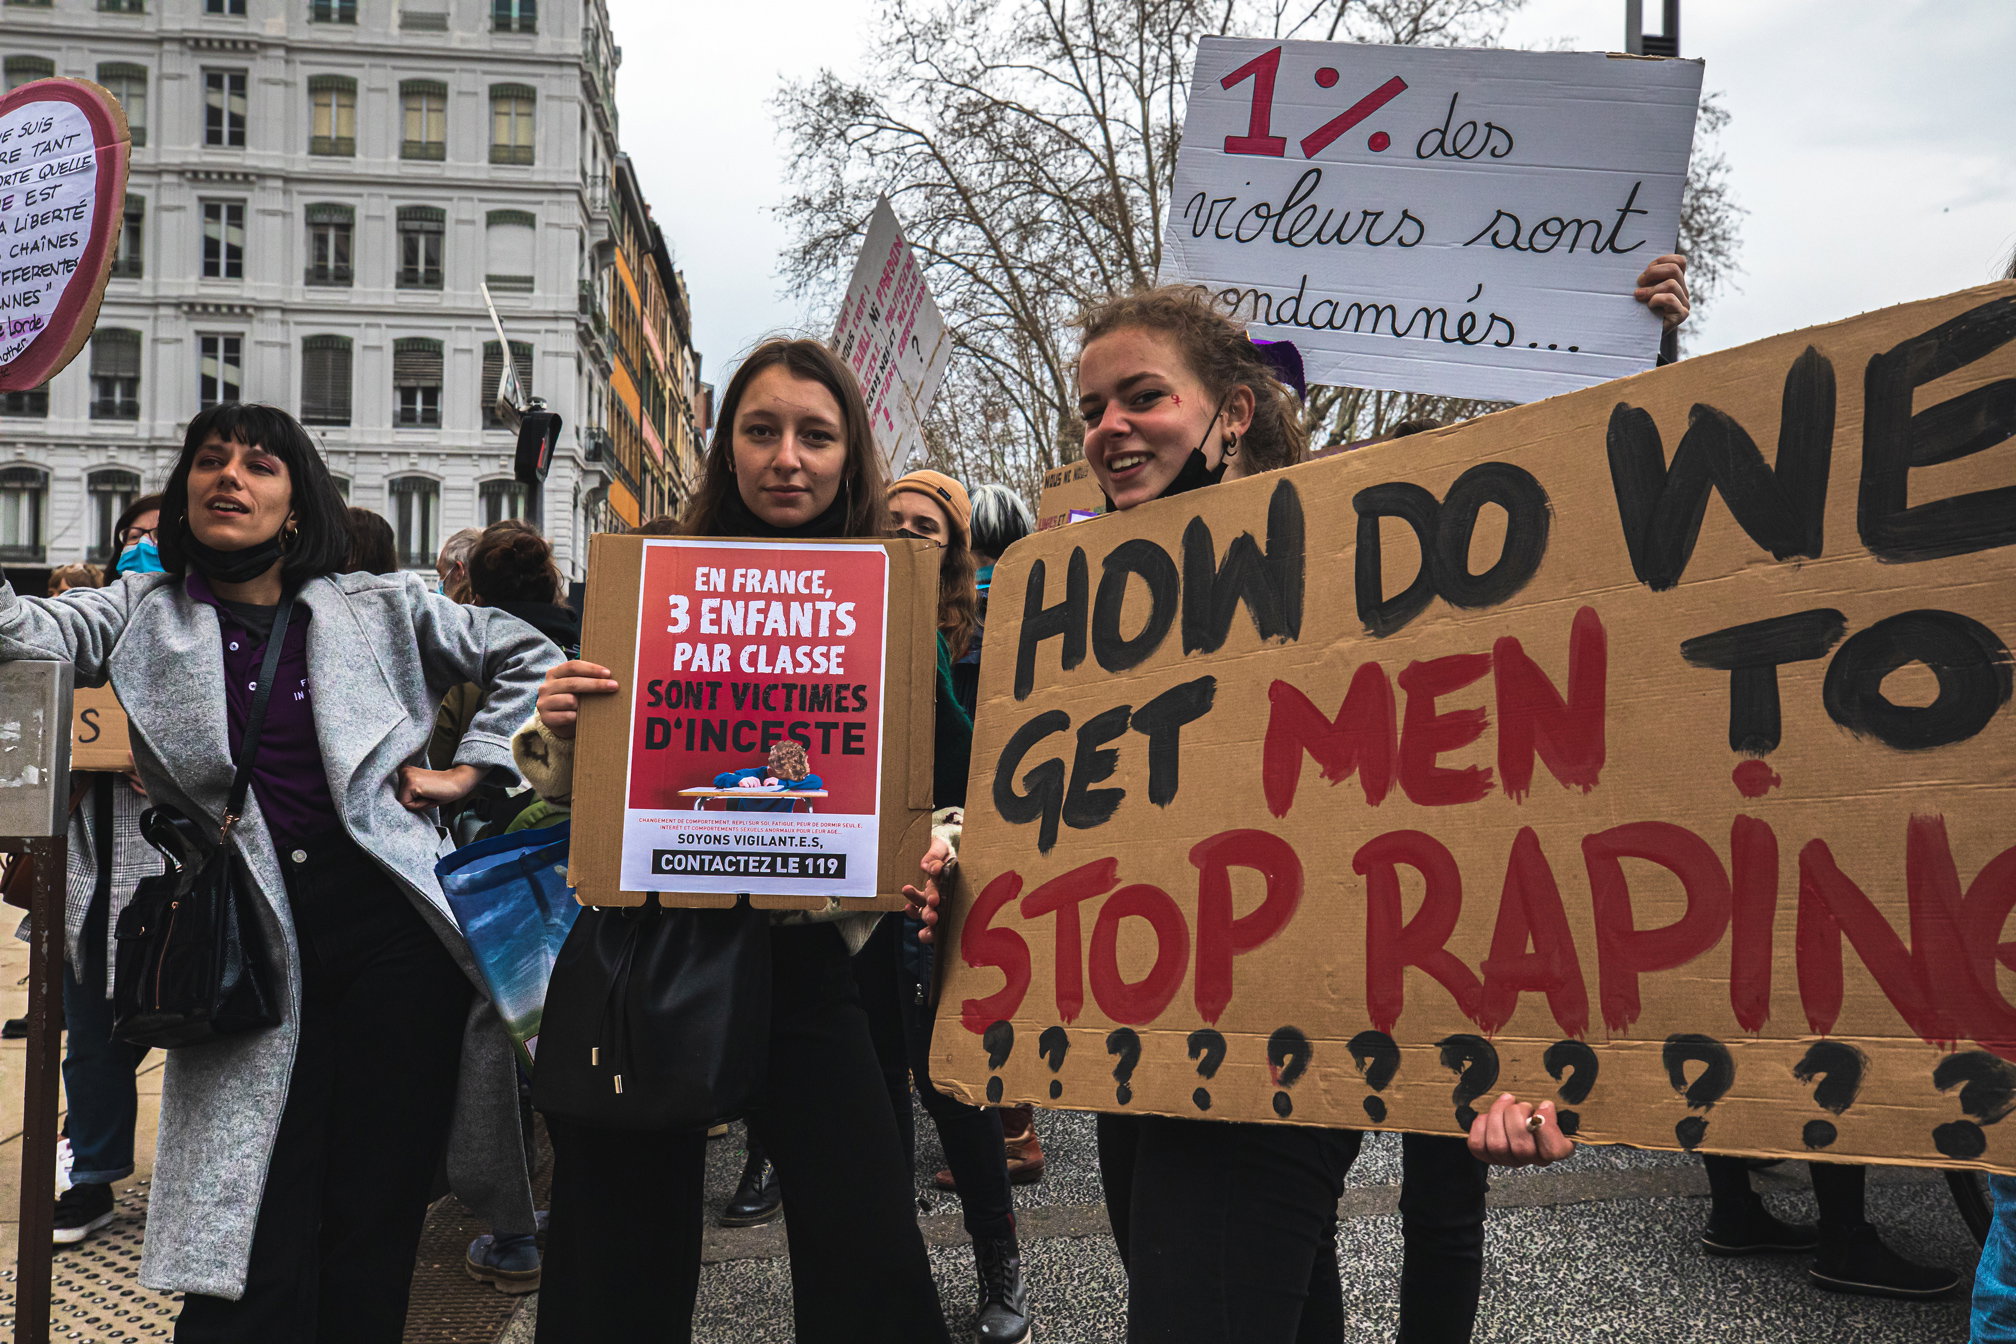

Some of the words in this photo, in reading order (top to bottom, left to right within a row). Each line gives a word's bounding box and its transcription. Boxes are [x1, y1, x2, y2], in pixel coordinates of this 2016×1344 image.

[1415, 91, 1515, 160] des
[32, 133, 81, 157] TANT
[38, 155, 92, 180] QUELLE
[0, 194, 15, 212] E
[25, 184, 63, 207] EST
[1183, 167, 1426, 248] violeurs
[1462, 181, 1649, 254] sont
[876, 234, 903, 307] PARDON
[8, 313, 45, 337] Lorde
[911, 335, 923, 363] ?
[1013, 477, 1306, 702] HOW
[1352, 461, 1555, 638] DO
[1606, 296, 2016, 592] WE
[695, 566, 725, 592] EN
[732, 568, 833, 599] FRANCE,
[666, 594, 690, 634] 3
[700, 598, 857, 637] ENFANTS
[673, 642, 731, 672] PAR
[739, 645, 845, 675] CLASSE
[647, 680, 723, 710] SONT
[730, 682, 868, 713] VICTIMES
[78, 708, 101, 744] S
[645, 717, 866, 755] D'INCESTE
[992, 674, 1217, 856] GET
[1262, 605, 1607, 818] MEN
[1680, 608, 2016, 758] TO
[677, 833, 730, 846] SOYONS
[734, 835, 824, 849] VIGILANT.E.S,
[660, 854, 771, 873] CONTACTEZ
[776, 857, 799, 874] LE
[805, 857, 839, 875] 119
[960, 828, 1305, 1034] STOP
